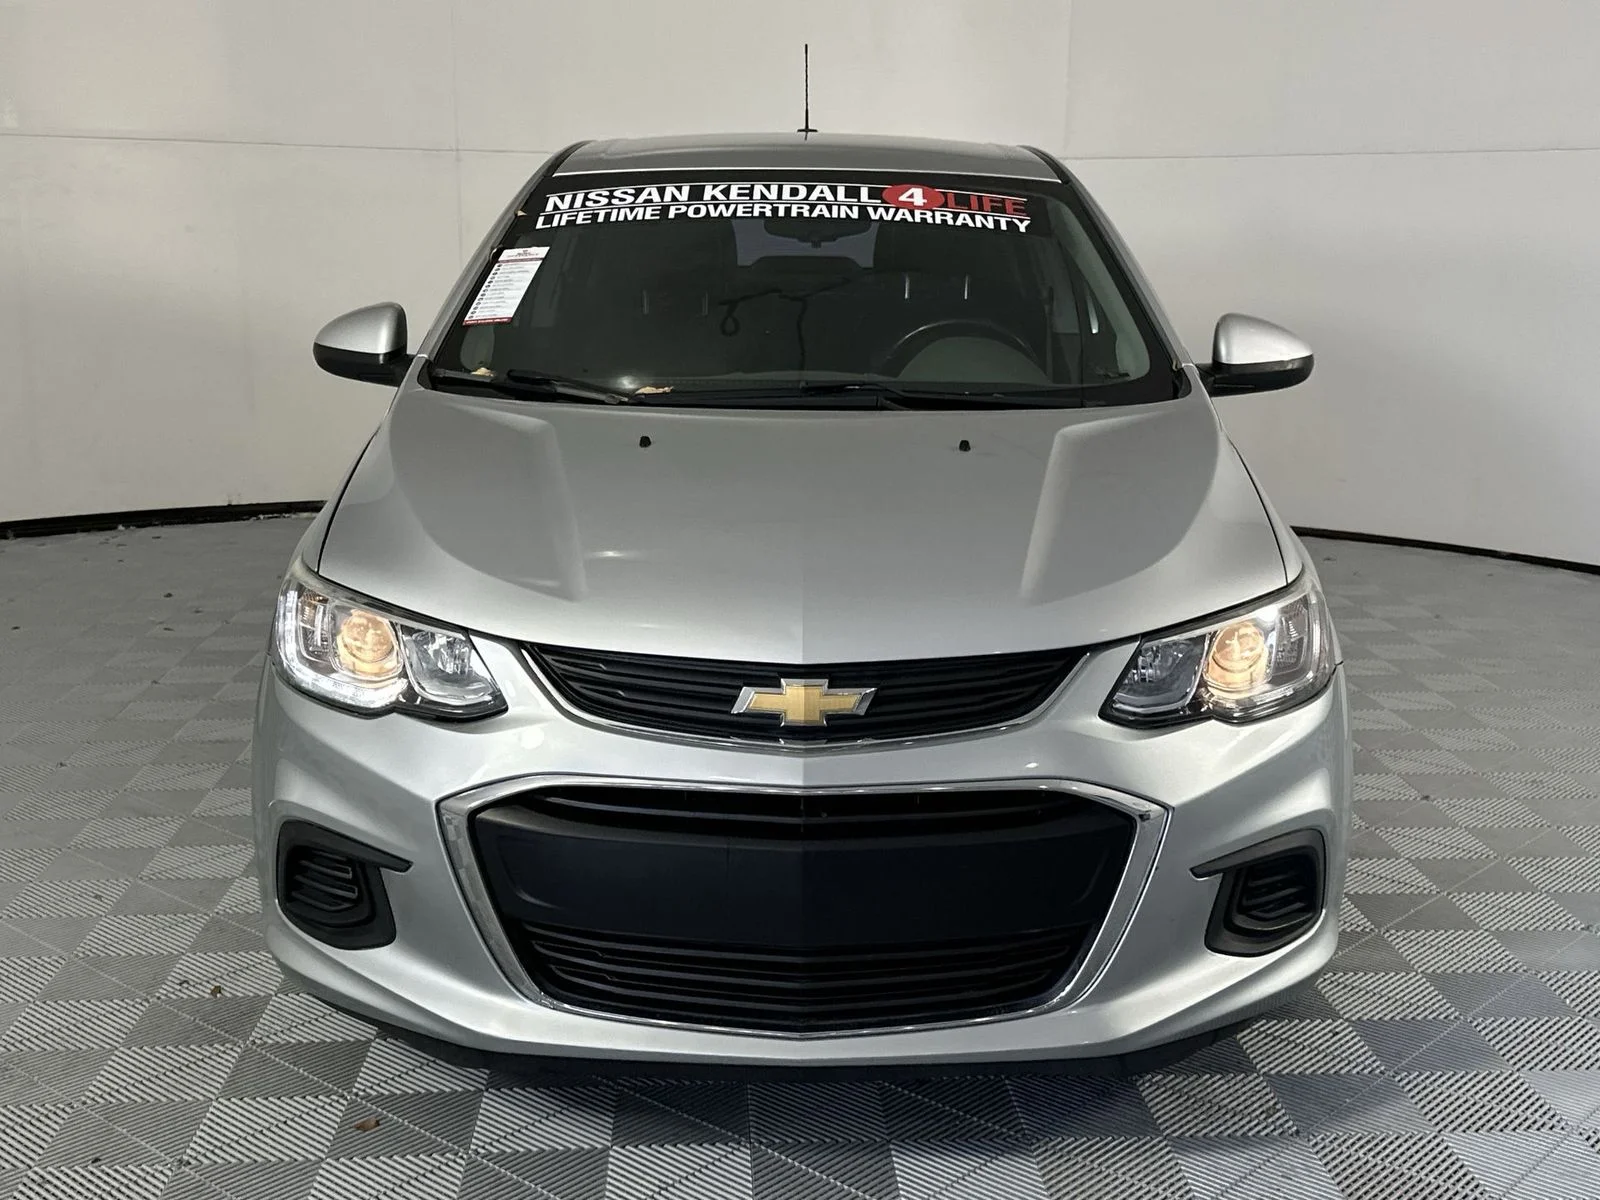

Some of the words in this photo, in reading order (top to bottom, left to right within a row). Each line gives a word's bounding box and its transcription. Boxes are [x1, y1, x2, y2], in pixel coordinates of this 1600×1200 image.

[544, 185, 690, 212] NISSAN
[703, 184, 882, 204] KENDALL
[898, 187, 928, 206] 4
[947, 192, 1028, 216] LIFE
[535, 205, 662, 229] LIFETIME
[667, 203, 859, 220] POWERTRAIN
[867, 206, 1031, 233] WARRANTY
